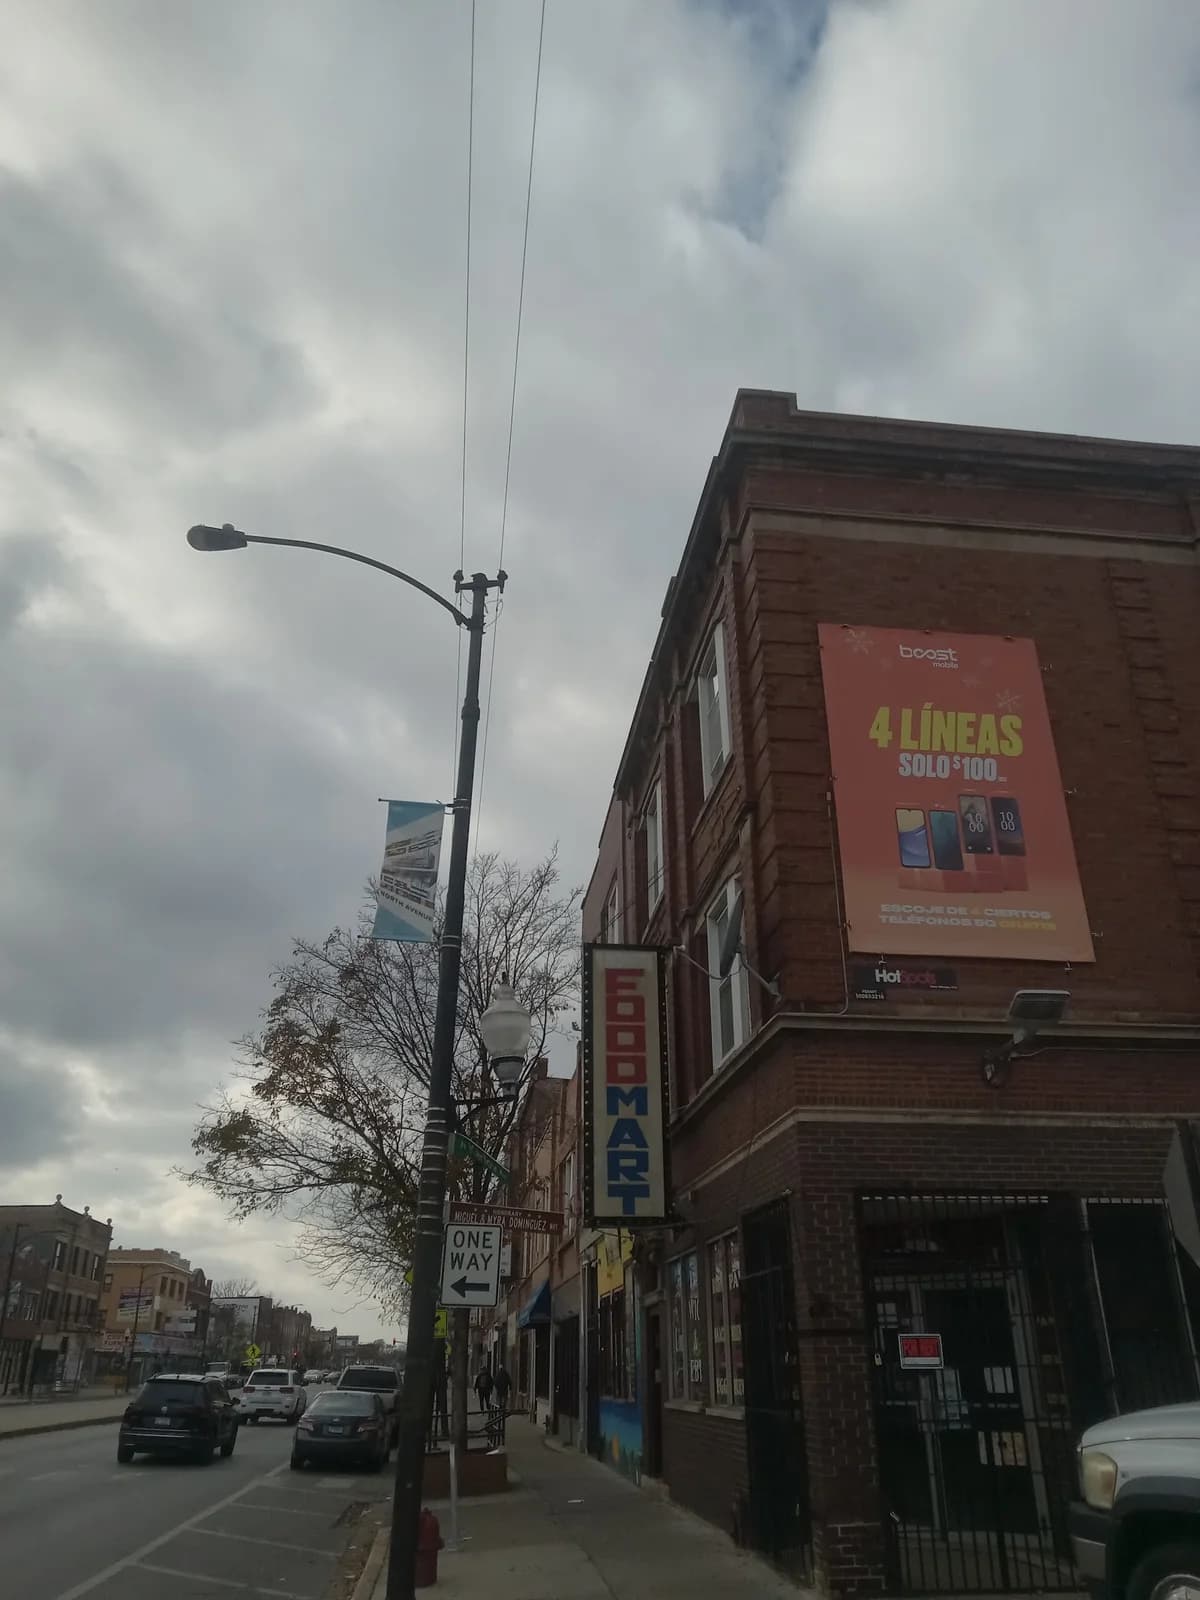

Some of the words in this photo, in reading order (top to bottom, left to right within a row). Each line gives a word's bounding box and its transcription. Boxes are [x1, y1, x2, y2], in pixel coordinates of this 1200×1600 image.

[899, 644, 959, 662] boost
[933, 661, 959, 670] mobile
[869, 706, 893, 749] 4
[899, 702, 1024, 758] LÍNEAS
[898, 753, 951, 780] SOLO
[952, 755, 998, 782] $100
[380, 890, 404, 908] NORTH
[405, 903, 433, 921] AVENUE
[880, 903, 944, 914] ESCOJE
[945, 905, 969, 916] DE
[604, 967, 648, 1085] FOOD
[606, 1085, 650, 1216] MART
[454, 1210, 478, 1223] MIGUEL
[488, 1215, 506, 1228] MYRA
[509, 1217, 547, 1231] DOMINGUEZ
[453, 1230, 493, 1249] ONE
[450, 1252, 493, 1271] WAY
